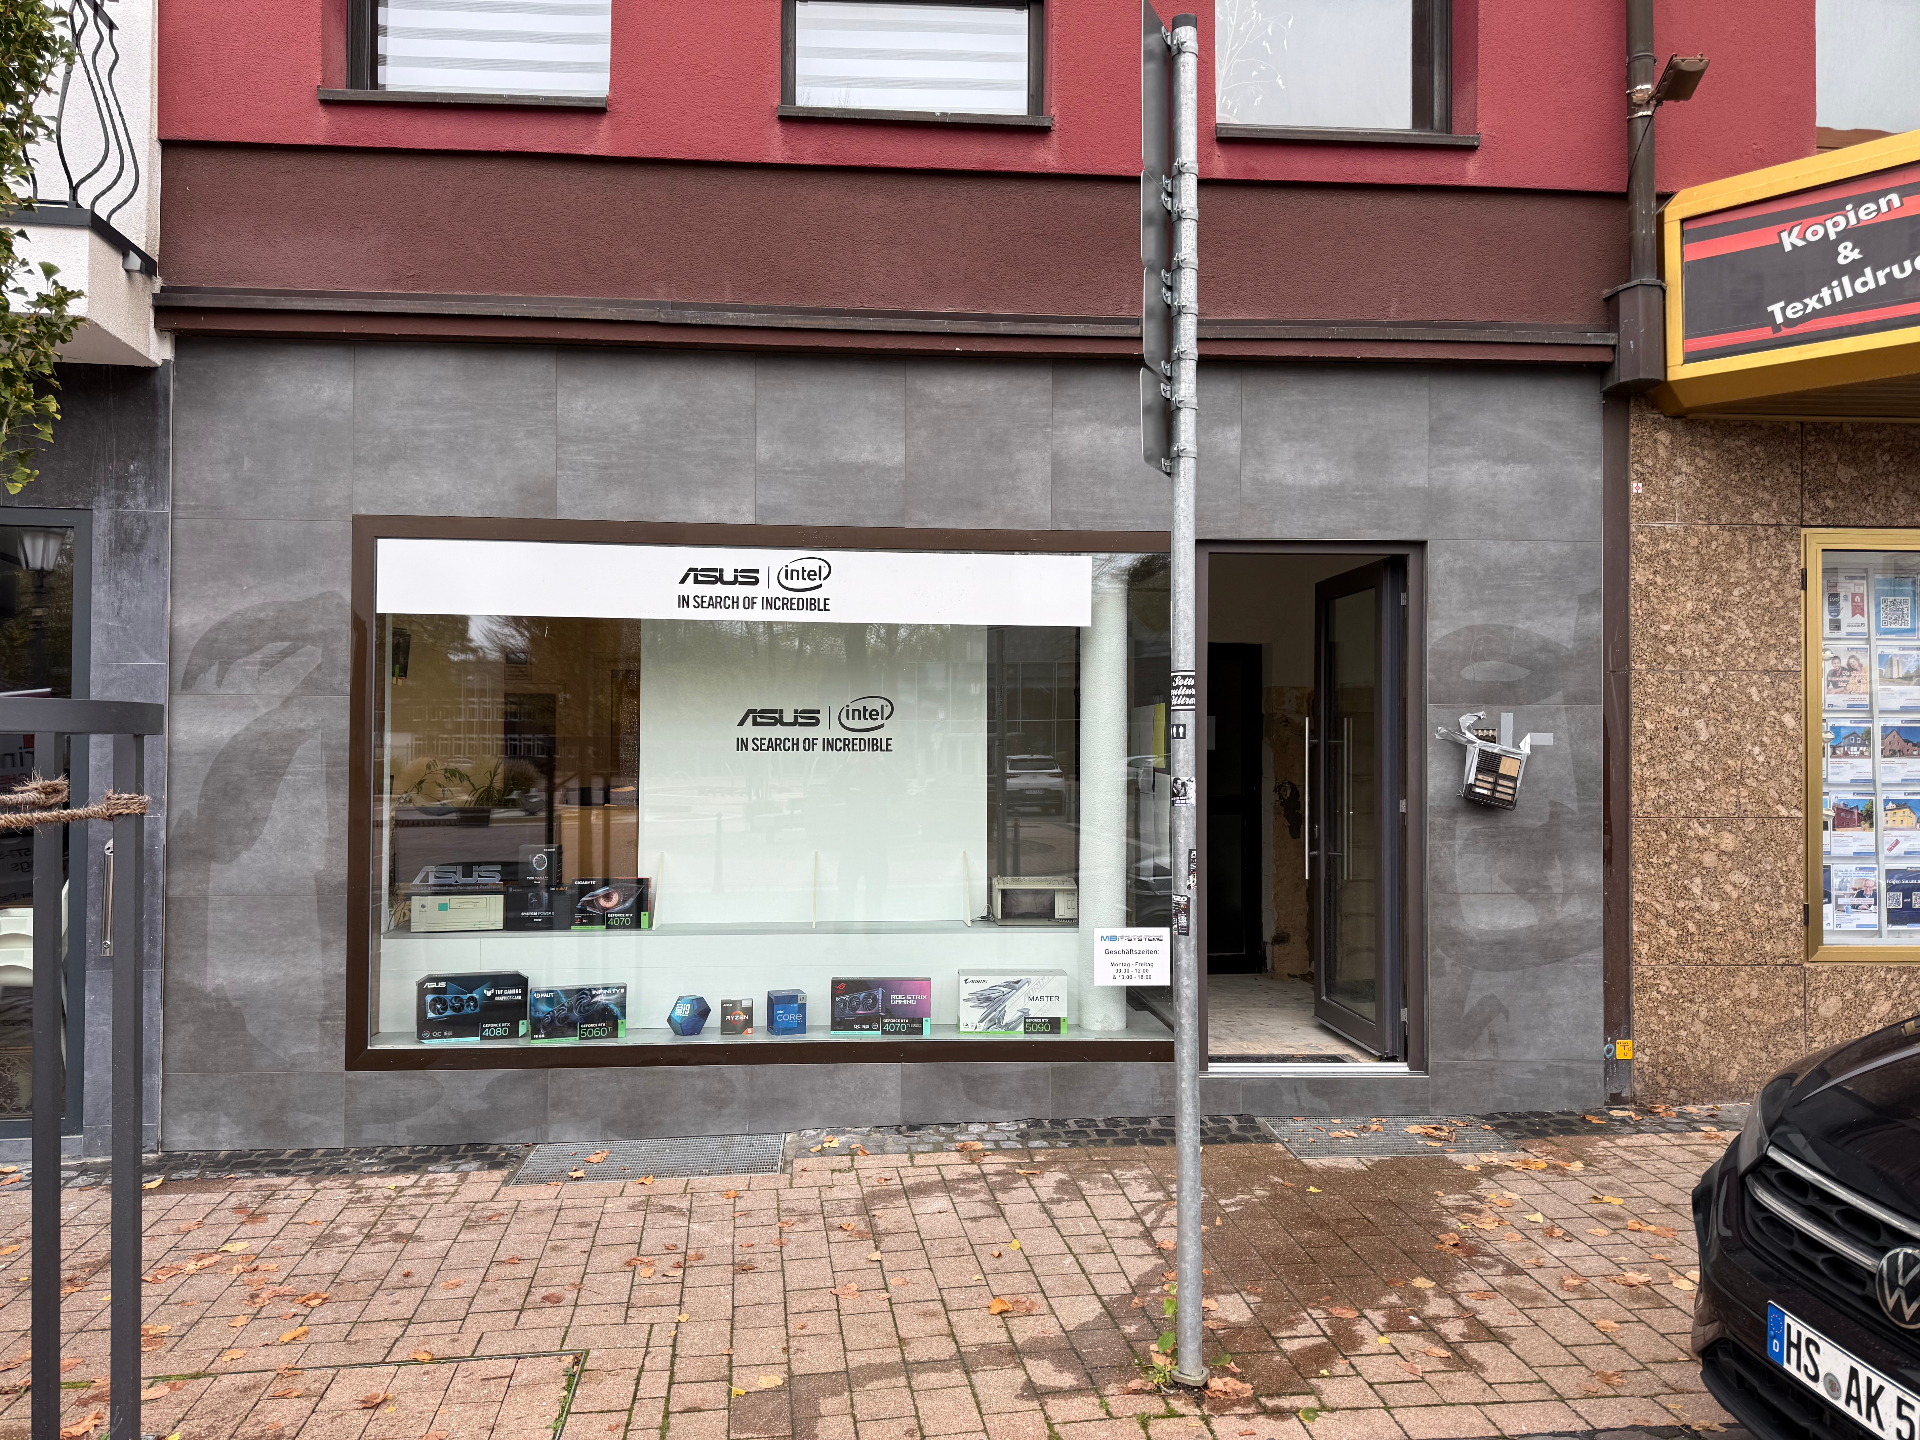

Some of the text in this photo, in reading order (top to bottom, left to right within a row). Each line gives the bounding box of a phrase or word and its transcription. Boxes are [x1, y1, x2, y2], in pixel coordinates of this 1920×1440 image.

[1780, 192, 1902, 253] Kopien
[1836, 241, 1863, 265] &
[678, 567, 760, 586] ASUS
[677, 594, 830, 611] IN SEARCH OF INCREDIBLE
[736, 708, 820, 726] ASUS
[736, 737, 893, 752] IN SEARCH OF INCREDIBLE
[412, 864, 502, 884] ASUS
[607, 917, 631, 926] 4070
[482, 1027, 509, 1037] 4080
[580, 1027, 607, 1038] 5060
[883, 1023, 907, 1032] 4070
[1025, 1023, 1051, 1032] 5090
[1772, 1339, 1780, 1353] D
[1785, 1322, 1821, 1384] HS
[1844, 1365, 1886, 1432] AK
